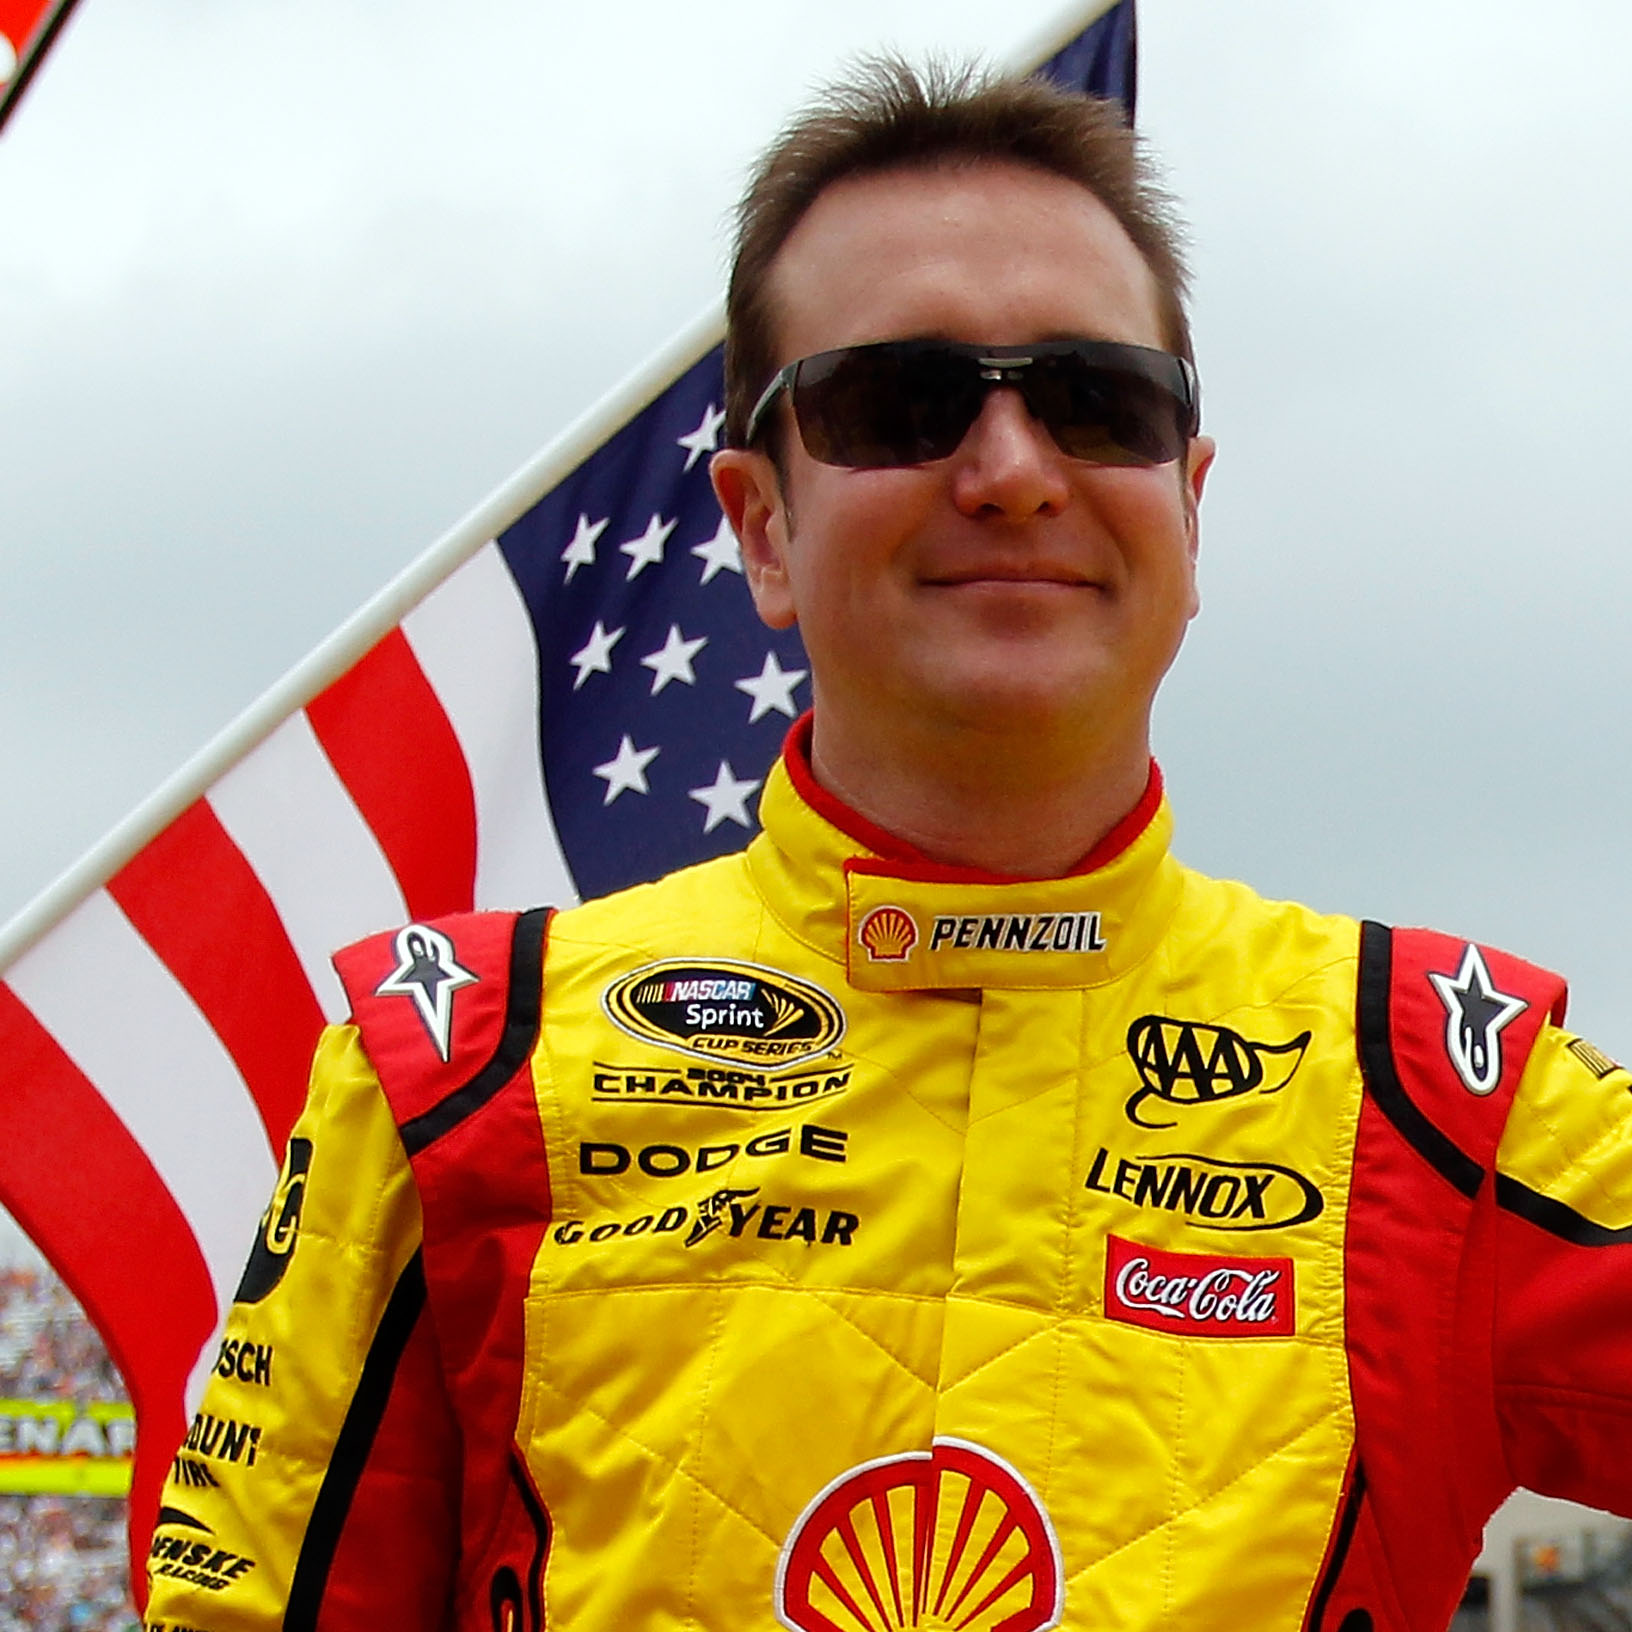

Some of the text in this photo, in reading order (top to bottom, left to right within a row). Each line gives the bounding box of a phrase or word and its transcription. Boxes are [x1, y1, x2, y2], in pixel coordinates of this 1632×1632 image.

[929, 912, 1107, 952] PENNZOIL
[670, 980, 751, 1001] NASCAR
[685, 1003, 765, 1030] Sprint
[692, 1036, 814, 1057] CUP SERIES
[1134, 1017, 1252, 1101] AAA
[593, 1070, 852, 1102] CHAMPION
[686, 1066, 767, 1087] 2004
[579, 1124, 849, 1178] DODGE
[1085, 1147, 1274, 1220] LENNOX
[1115, 1257, 1280, 1323] Coca-Cola
